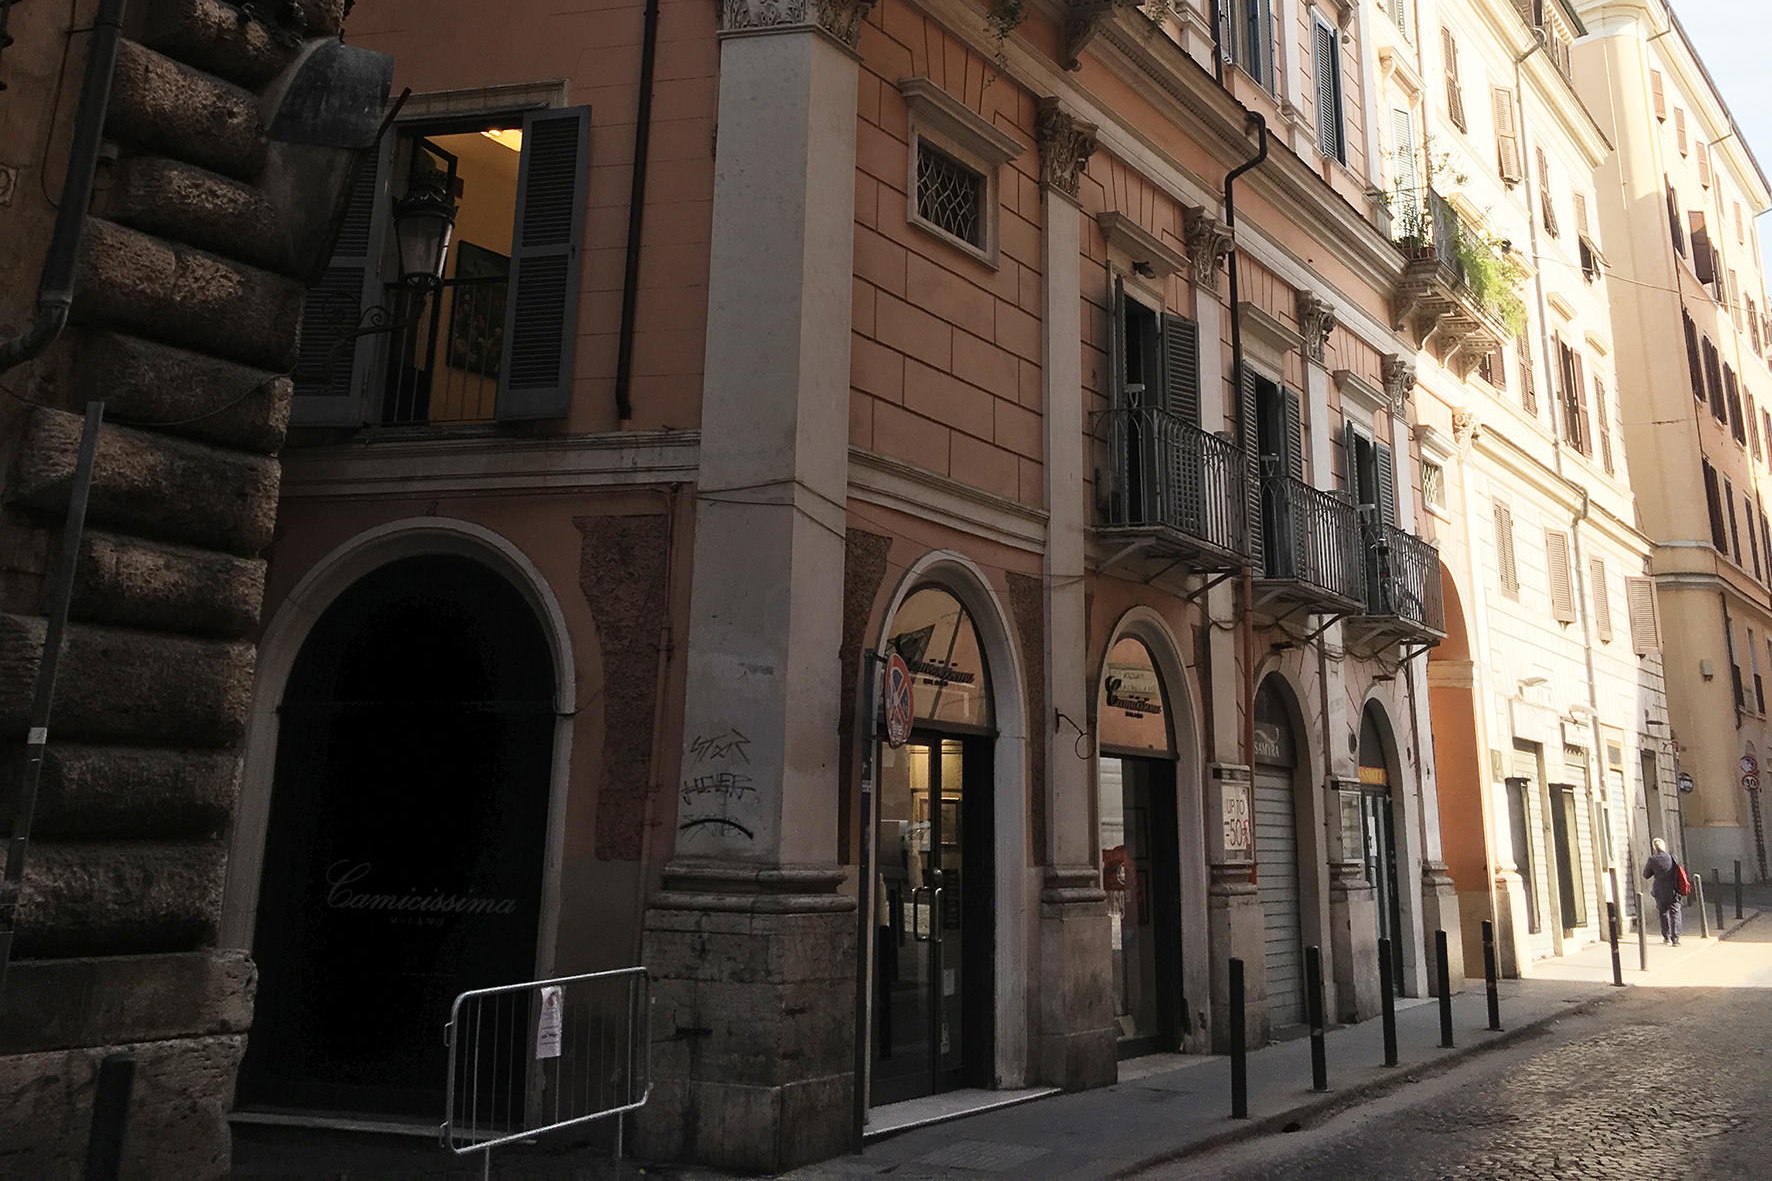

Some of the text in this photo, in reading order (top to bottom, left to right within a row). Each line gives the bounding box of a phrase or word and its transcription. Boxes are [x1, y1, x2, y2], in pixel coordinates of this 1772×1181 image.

[1745, 778, 1756, 788] 30
[1226, 798, 1246, 815] UP TO
[325, 859, 517, 915] Camicissima
